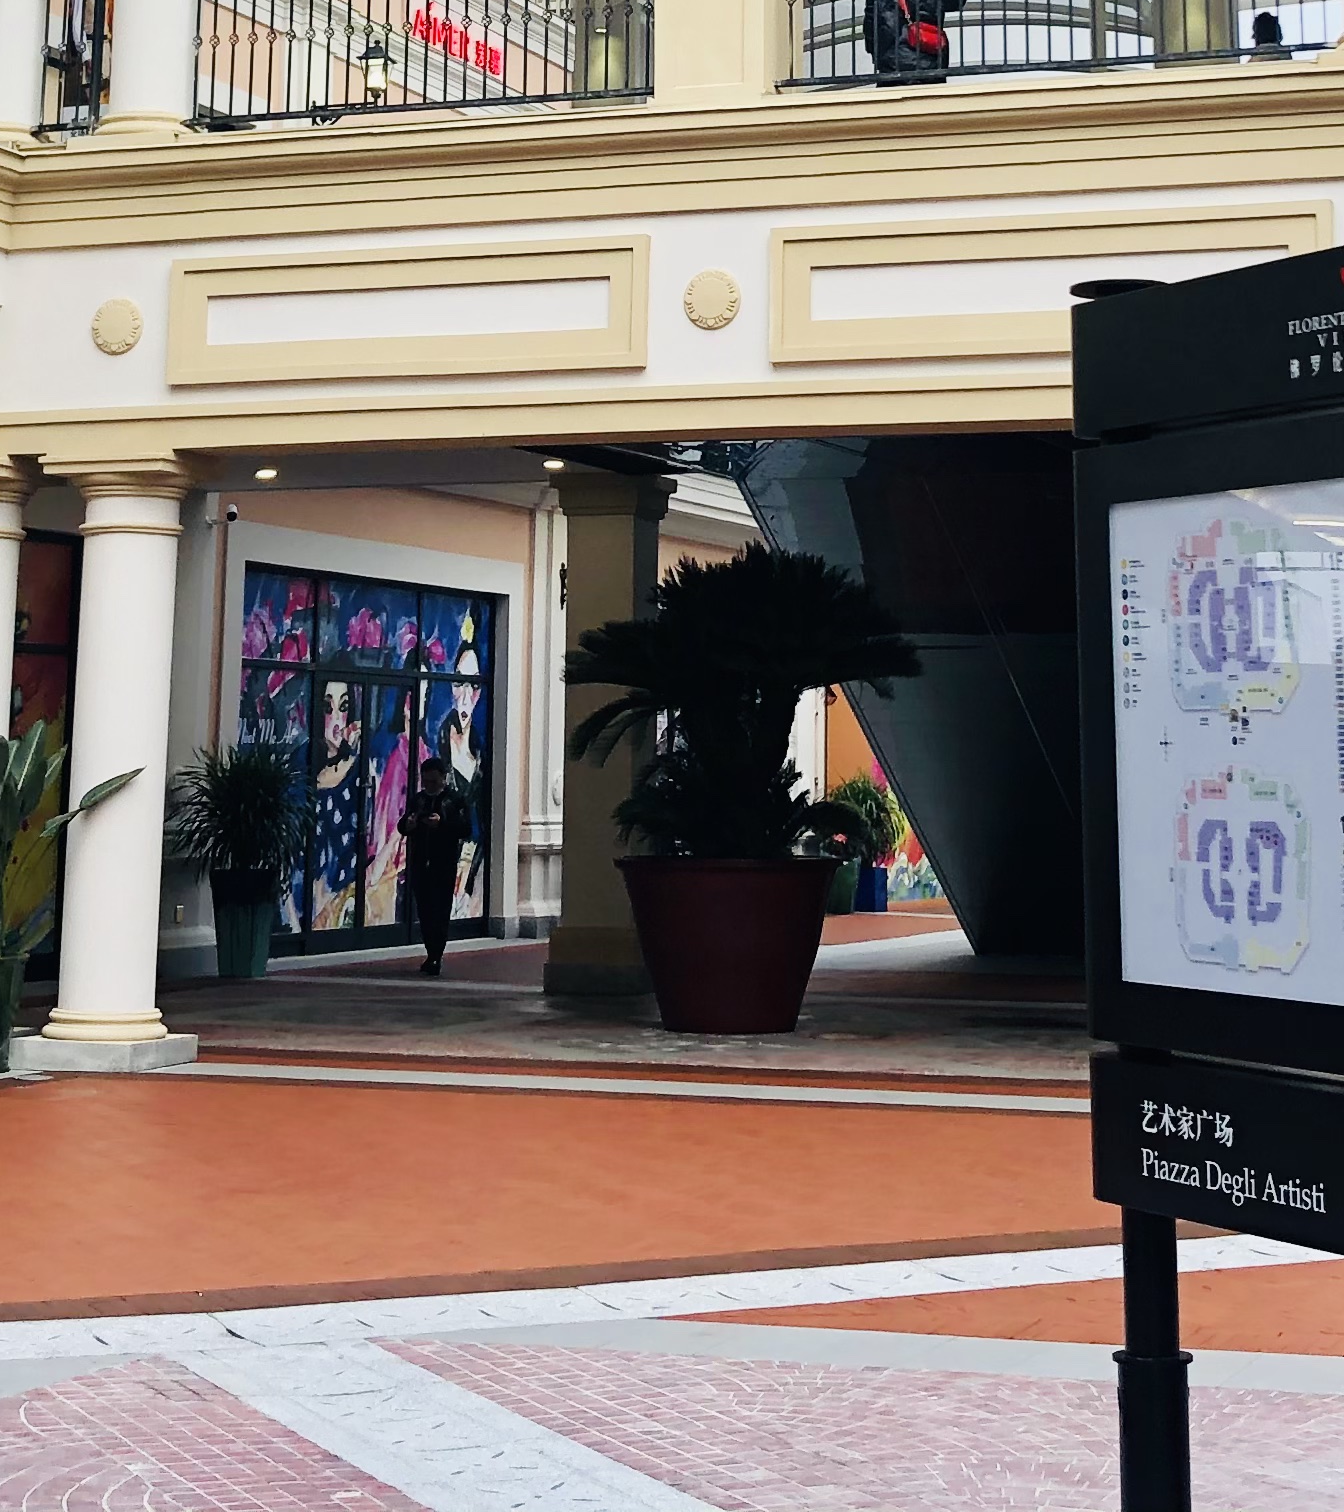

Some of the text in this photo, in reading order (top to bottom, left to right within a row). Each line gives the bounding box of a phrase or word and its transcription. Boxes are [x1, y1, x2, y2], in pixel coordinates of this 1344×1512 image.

[1140, 1099, 1234, 1147] 艺术家广场
[1140, 1147, 1327, 1214] Piazza Degli Artisti
